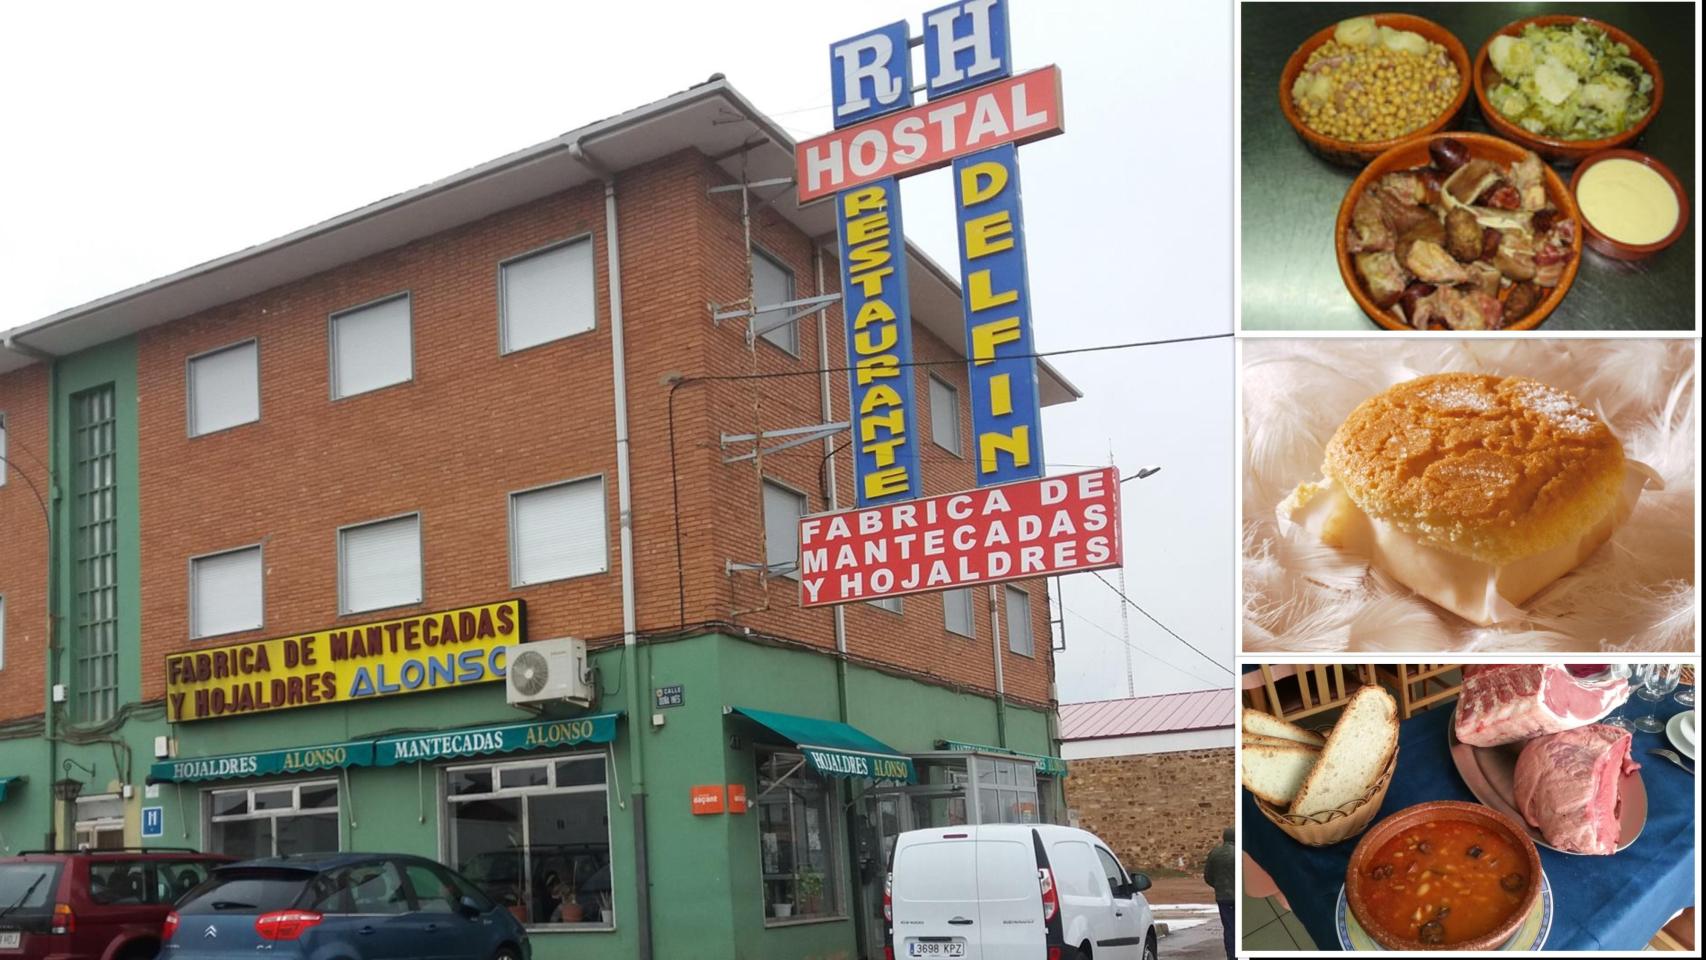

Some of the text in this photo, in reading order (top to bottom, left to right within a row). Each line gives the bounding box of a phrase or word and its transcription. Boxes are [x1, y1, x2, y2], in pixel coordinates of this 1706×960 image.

[834, 0, 1000, 116] R H
[806, 83, 1047, 192] HOSTAL
[843, 185, 909, 500] RESTAURANTE
[960, 161, 1030, 474] DELFIN
[802, 472, 1105, 544] FABRICA DE
[802, 504, 1108, 574] MANTECADAS
[803, 535, 1110, 602] Y HOJALDRES
[168, 604, 514, 685] FABRICA DE MANTECADAS
[169, 693, 186, 721] Y
[195, 671, 336, 717] HOJALDRES
[664, 687, 680, 695] CALLE
[173, 747, 346, 780] HOJALDRES ALONSO
[394, 720, 593, 759] MANTECADAS ALONSO
[811, 751, 908, 778] HOJALDRES ALONSO
[916, 943, 962, 954] 3698 KPZ
